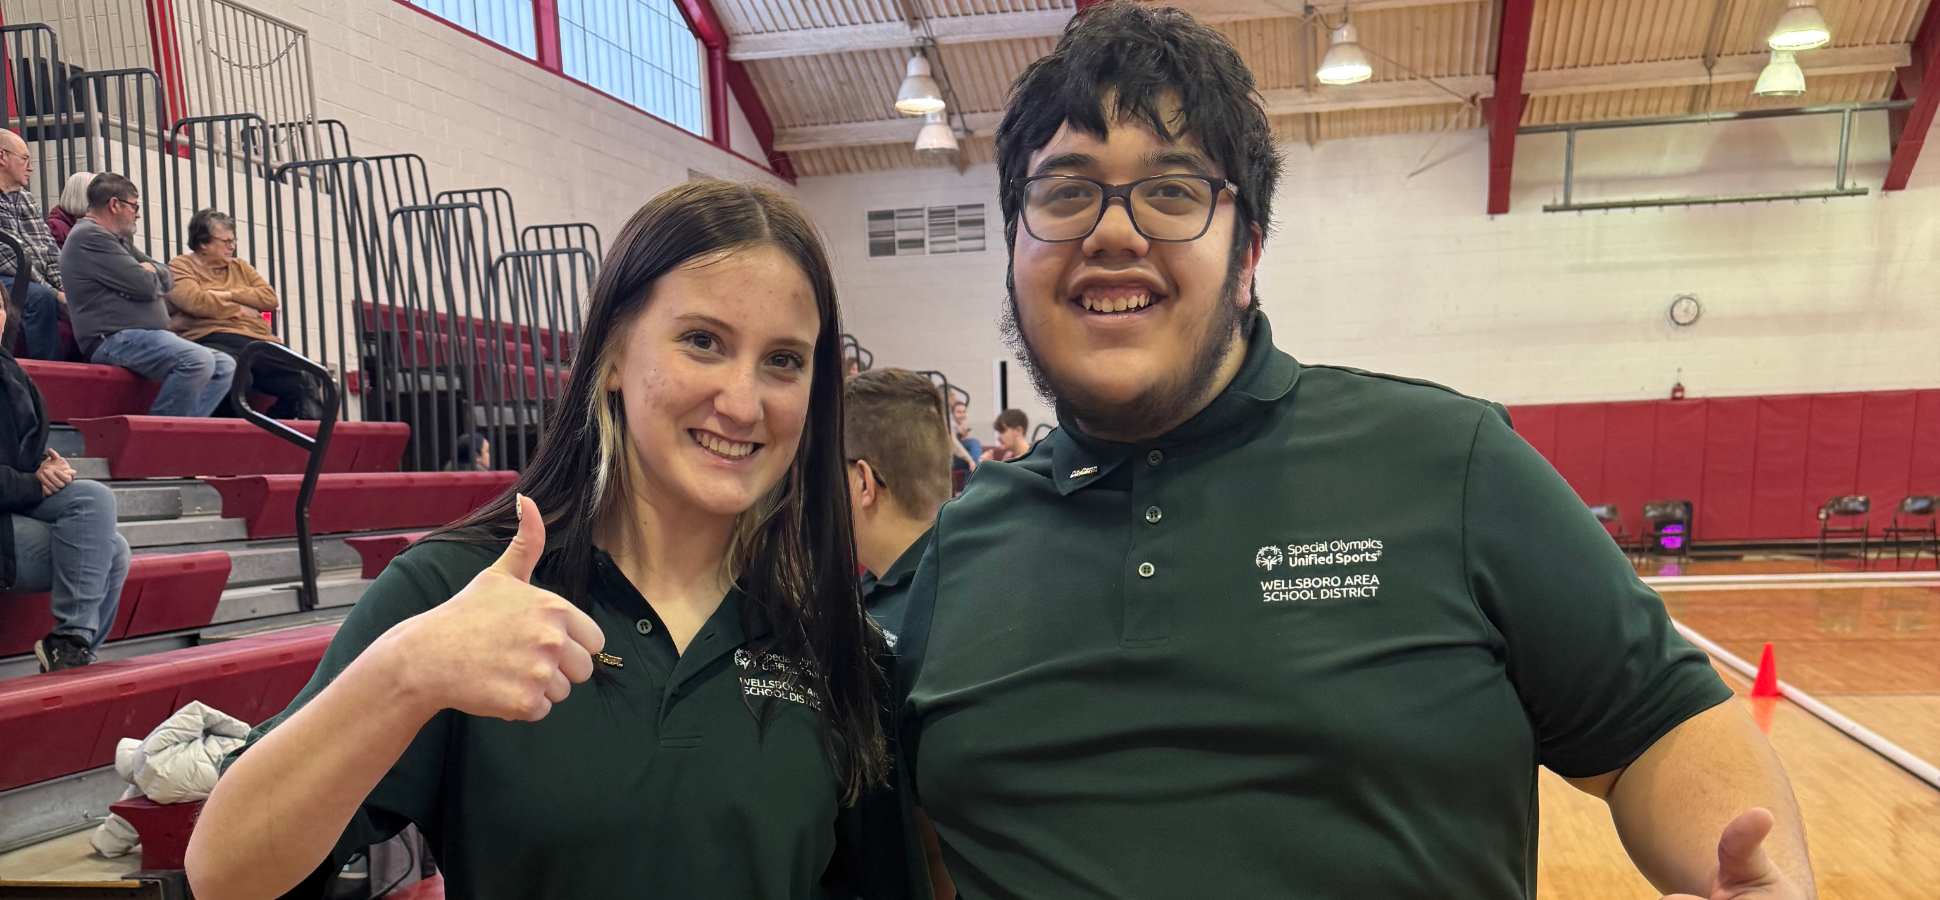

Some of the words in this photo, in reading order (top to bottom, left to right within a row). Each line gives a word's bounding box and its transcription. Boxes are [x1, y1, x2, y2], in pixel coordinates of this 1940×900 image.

[1287, 541, 1328, 556] Special
[1330, 538, 1383, 552] Olympics
[1289, 553, 1333, 567] Unified
[1260, 576, 1341, 591] WELLSBORO
[1344, 574, 1380, 586] AREA
[1263, 589, 1317, 602] SCHOOL
[1320, 586, 1378, 599] DISTRICT
[744, 686, 789, 700] SCHOOL
